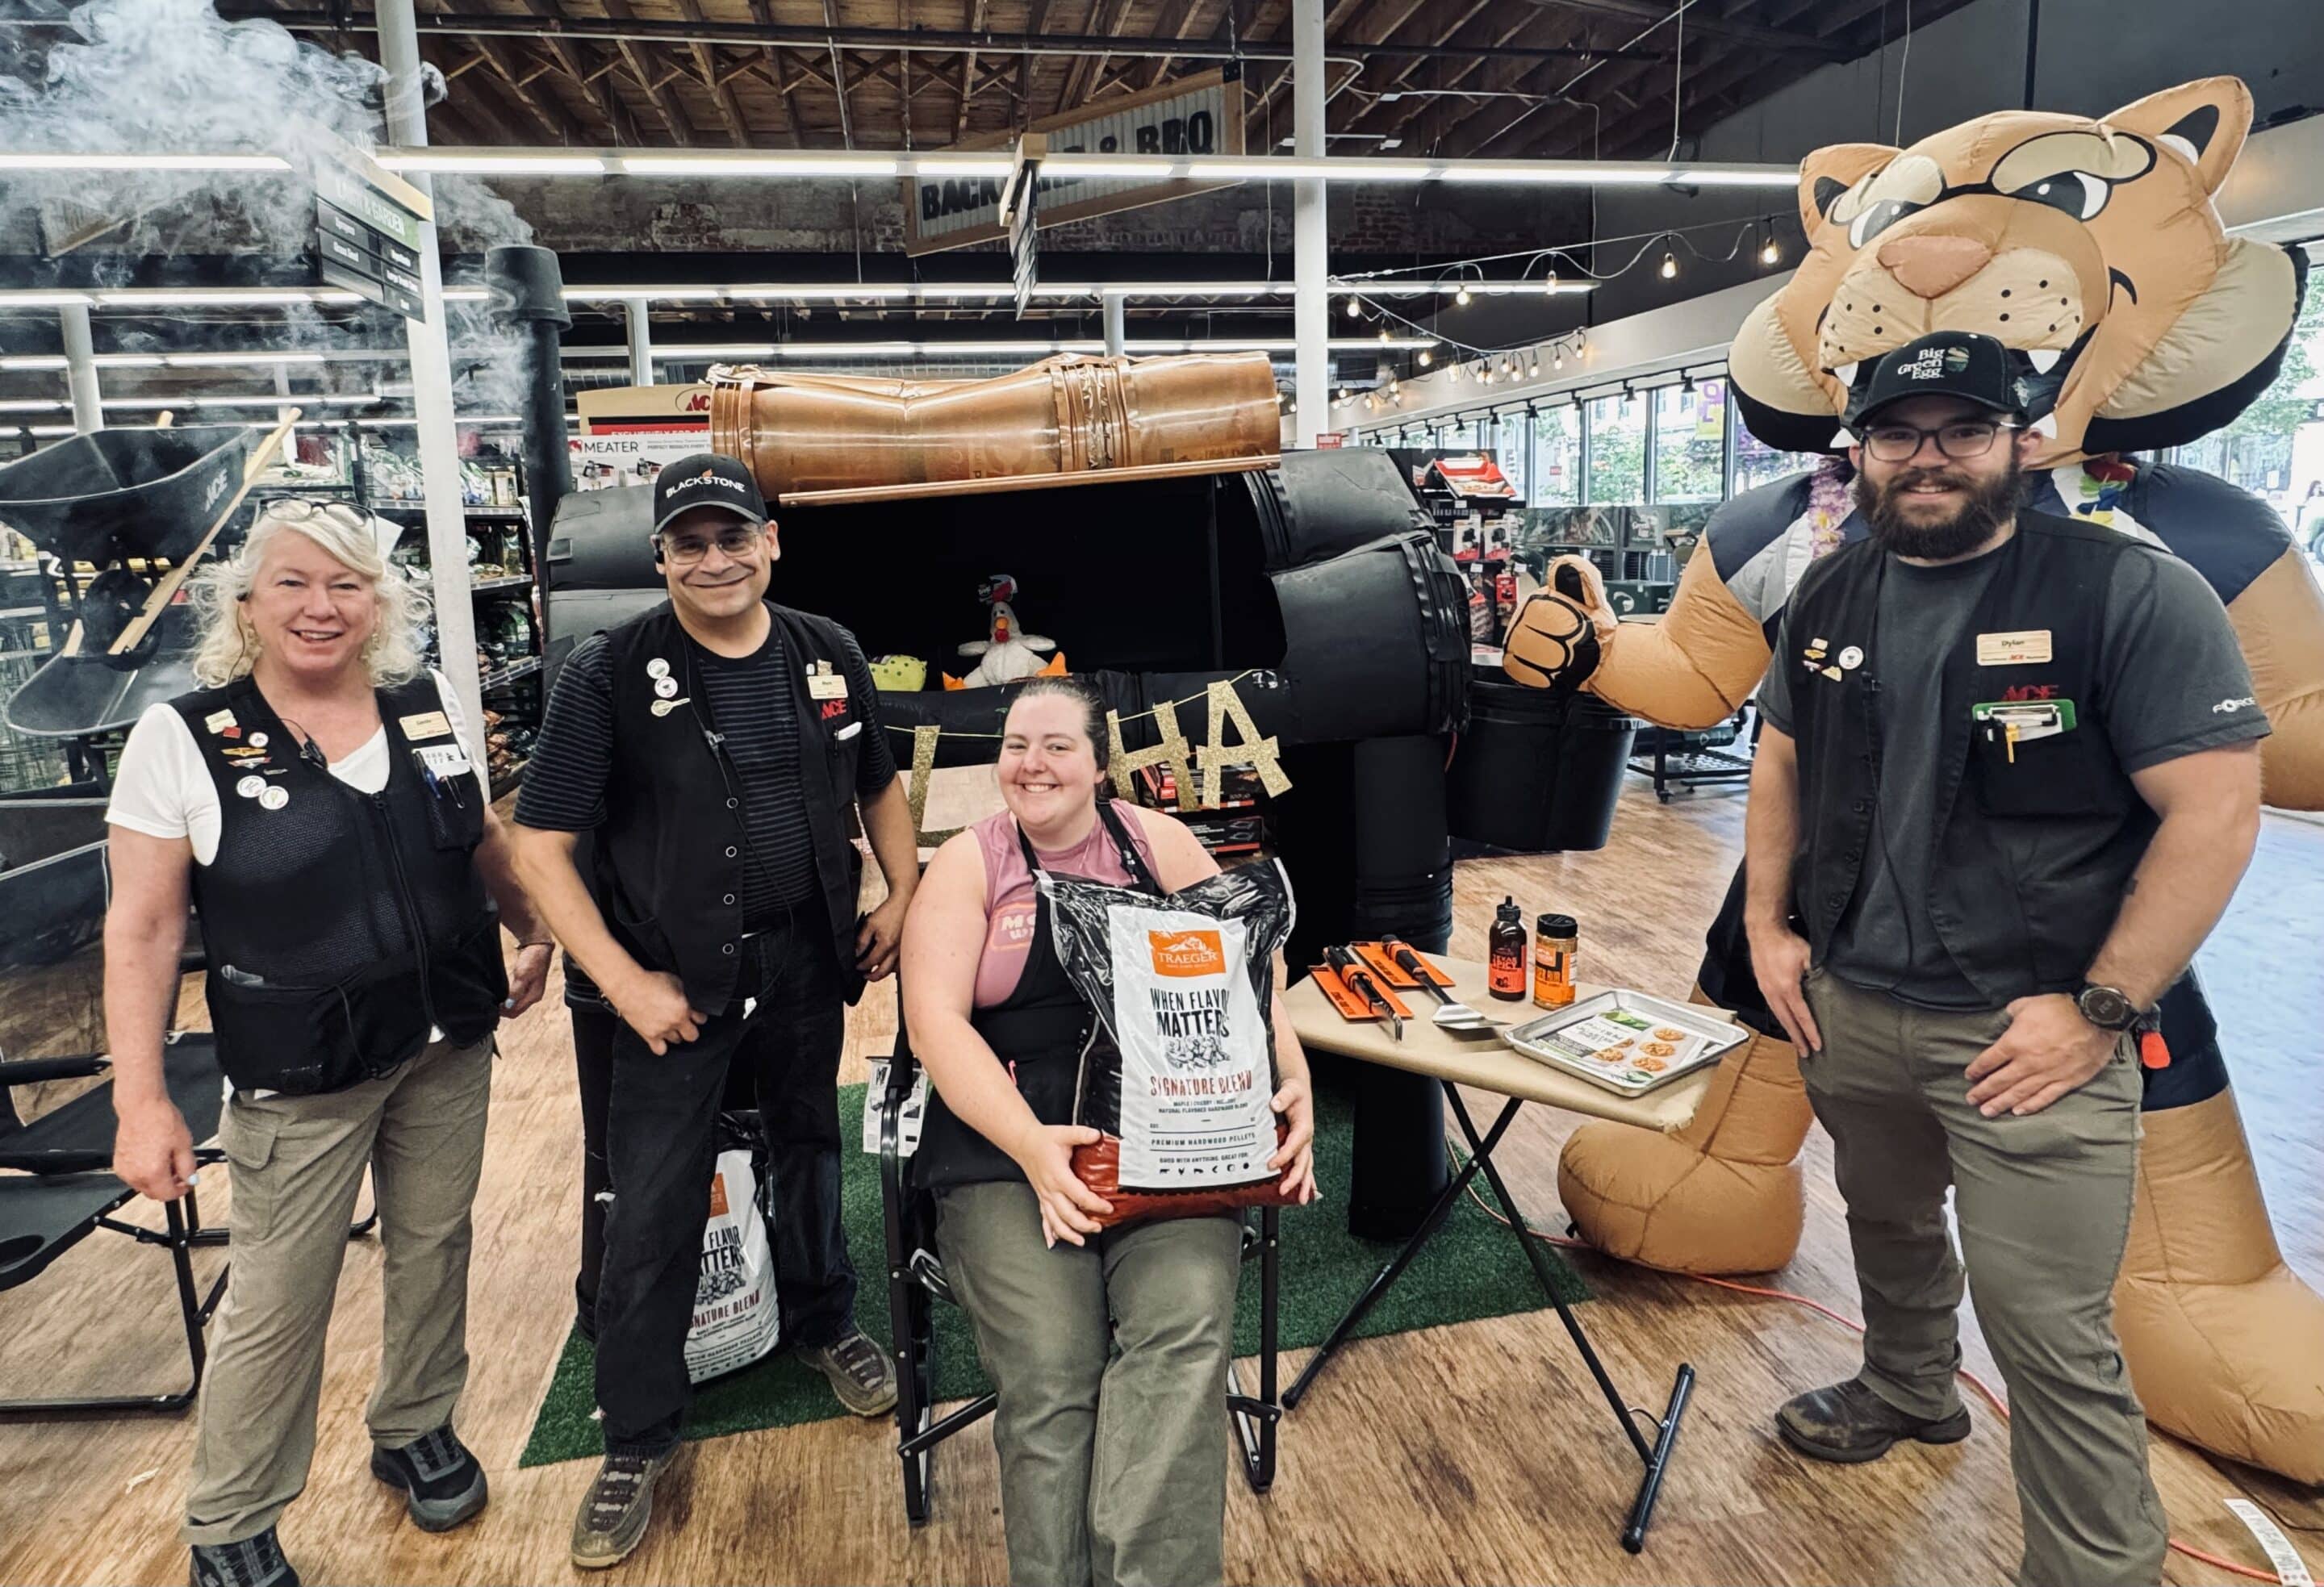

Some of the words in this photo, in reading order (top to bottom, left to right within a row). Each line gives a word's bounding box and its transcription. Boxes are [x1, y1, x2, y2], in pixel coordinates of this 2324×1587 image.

[1136, 111, 1214, 154] BBQ
[1918, 348, 1946, 361] Big
[1897, 360, 1943, 375] Green
[685, 393, 710, 411] AC
[584, 441, 638, 453] MEATER
[204, 467, 228, 512] ACE
[666, 475, 746, 499] BLACKSTONE
[821, 699, 847, 720] ACE
[1157, 951, 1218, 964] TRAEGER
[1150, 988, 1185, 1011] WHEN
[1156, 1009, 1231, 1038] MATTERS
[1150, 1076, 1216, 1096] SIGNATURE
[1218, 1070, 1253, 1093] BLEND
[1188, 1137, 1227, 1146] HARDWOOD
[1229, 1132, 1256, 1143] PELLETS
[733, 1288, 760, 1314] BLEND
